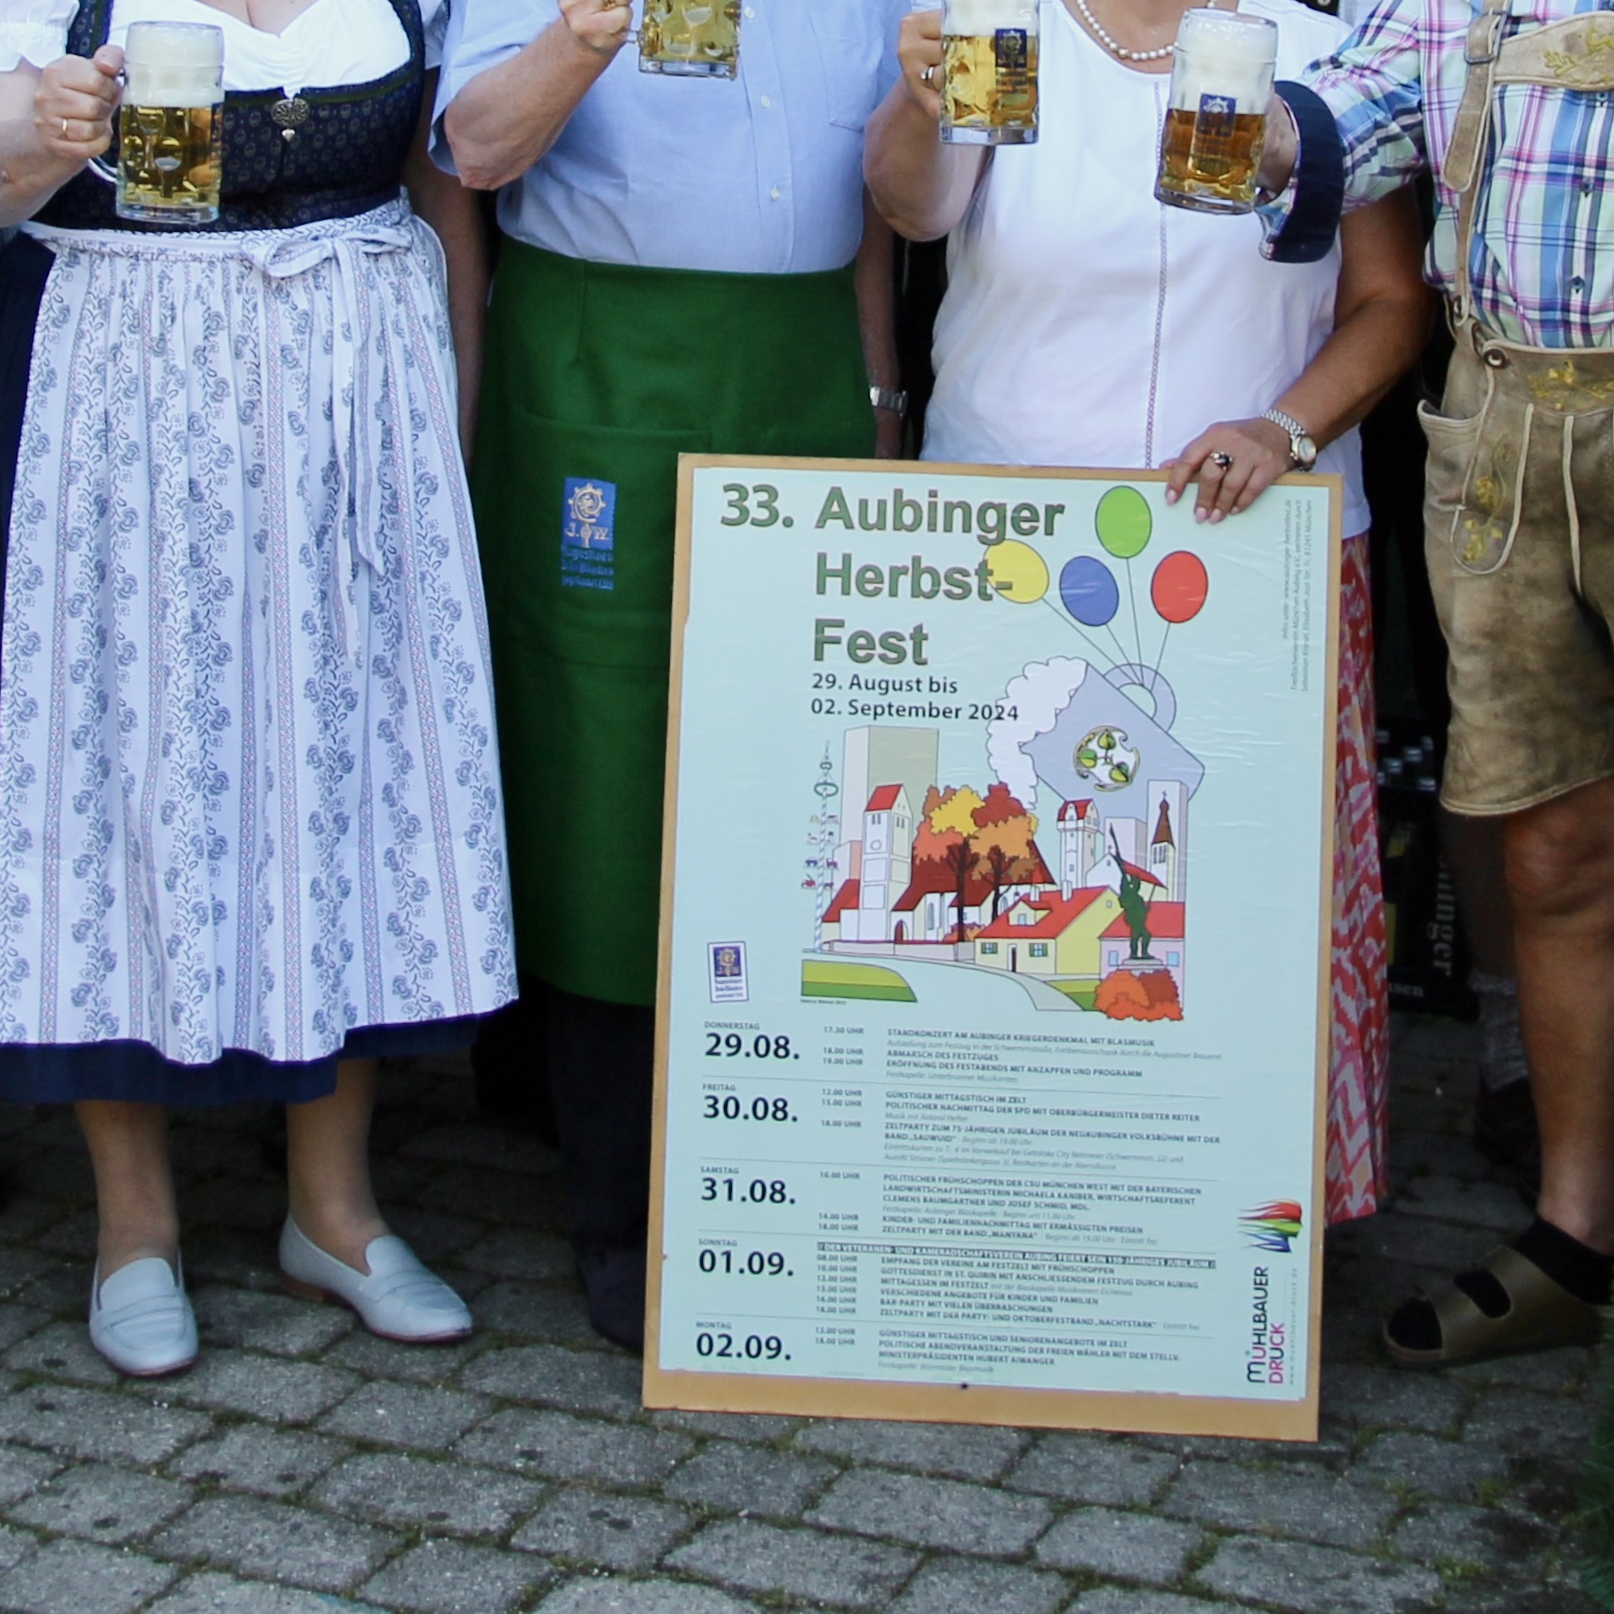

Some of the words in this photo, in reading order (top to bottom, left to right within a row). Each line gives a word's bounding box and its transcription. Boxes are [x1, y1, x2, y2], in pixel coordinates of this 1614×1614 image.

[719, 482, 795, 528] 33.
[814, 486, 1066, 545] Aubinger
[815, 553, 1013, 601] Herbst-
[813, 618, 928, 666] Fest
[811, 673, 843, 693] 29.
[848, 675, 923, 697] August
[930, 677, 958, 694] bis
[811, 699, 842, 716] 02.
[847, 700, 962, 721] September
[967, 703, 1020, 721] 2024
[704, 1021, 760, 1030] DONNERSTAG
[704, 1031, 800, 1060] 29.08.
[887, 1028, 953, 1038] STANDKONZERT
[953, 1030, 968, 1039] AM
[968, 1031, 1011, 1041] AUBINGER
[1089, 1036, 1106, 1045] MIT
[1106, 1037, 1154, 1047] BLASMUSIK
[886, 1048, 933, 1058] ABMARSCH
[934, 1050, 951, 1059] DES
[951, 1051, 998, 1061] FESTZUGES
[886, 1058, 937, 1069] ERÖFFNUNG
[937, 1061, 954, 1070] DES
[955, 1062, 1008, 1072] FESTABENDS
[1009, 1064, 1025, 1073] MIT
[1026, 1065, 1071, 1075] ANZAPFEN
[1071, 1067, 1091, 1076] UND
[1092, 1067, 1142, 1078] PROGRAMM
[702, 1083, 736, 1091] FREITAG
[885, 1089, 933, 1100] GÜNSTIGER
[933, 1092, 995, 1103] MITTAGSTISCH
[1007, 1095, 1026, 1104] ZELT
[703, 1093, 798, 1122] 30.08.
[884, 1100, 938, 1110] POLITISCHER
[939, 1103, 994, 1113] NACHMITTAG
[995, 1105, 1013, 1114] DER
[1013, 1106, 1031, 1114] SPD
[1031, 1107, 1048, 1115] MIT
[1140, 1111, 1170, 1121] DIETER
[1171, 1113, 1200, 1122] REITER
[884, 1121, 930, 1131] ZELTPARTY
[930, 1123, 950, 1132] ZUM
[1049, 1128, 1067, 1137] DER
[1068, 1129, 1128, 1140] NEUAUBINGER
[1128, 1130, 1185, 1142] VOLKSBÜHNE
[1185, 1134, 1202, 1143] MIT
[1202, 1135, 1220, 1144] DER
[884, 1131, 908, 1140] BAND
[700, 1165, 739, 1174] SAMSTAG
[700, 1176, 796, 1205] 31.08.
[883, 1173, 936, 1183] POLITISCHER
[937, 1174, 1004, 1186] FRÜHSCHOPPEN
[1005, 1178, 1022, 1187] DER
[1023, 1179, 1041, 1188] CSU
[1041, 1179, 1084, 1190] MÜNCHEN
[1085, 1182, 1108, 1191] WEST
[1109, 1183, 1125, 1192] MIT
[1126, 1184, 1143, 1192] DER
[1144, 1184, 1201, 1195] BAYERISCHEN
[882, 1193, 921, 1203] CLEMENS
[921, 1195, 986, 1206] BAUMGARTNER
[986, 1198, 1006, 1207] UND
[1007, 1199, 1032, 1208] JOSEF
[1011, 1189, 1056, 1199] MICHAELA
[917, 1216, 936, 1225] UND
[1031, 1221, 1048, 1230] MIT
[1048, 1221, 1107, 1232] ERMÄSSIGTEN
[1108, 1225, 1143, 1234] PREISEN
[697, 1237, 738, 1246] SONNTAG
[698, 1248, 794, 1277] 01.09.
[881, 1256, 921, 1265] EMPFANG
[921, 1257, 939, 1266] DER
[939, 1258, 975, 1268] VEREINE
[975, 1260, 990, 1269] AM
[990, 1261, 1029, 1270] FESTZELT
[1030, 1263, 1046, 1271] MIT
[1047, 1262, 1114, 1274] FRÜHSCHOPPEN
[880, 1266, 942, 1277] GOTTESDIENST
[998, 1272, 1014, 1280] MIT
[1096, 1276, 1134, 1286] FESTZUG
[1134, 1278, 1165, 1287] DURCH
[1166, 1279, 1199, 1289] AUBING
[880, 1276, 937, 1287] MITTAGESSEN
[950, 1280, 988, 1289] FESTZELT
[880, 1287, 942, 1298] VERSCHIEDENE
[943, 1290, 987, 1300] ANGEBOTE
[1006, 1293, 1038, 1302] KINDER
[1039, 1295, 1058, 1303] UND
[1059, 1296, 1098, 1305] FAMILIEN
[926, 1299, 942, 1308] MIT
[943, 1300, 973, 1309] VIELEN
[695, 1320, 732, 1329] MONTAG
[879, 1308, 924, 1318] ZELTPARTY
[925, 1310, 941, 1319] MIT
[942, 1310, 960, 1319] DER
[991, 1313, 1010, 1322] UND
[695, 1331, 792, 1360] 02.09.
[878, 1327, 926, 1339] GÜNSTIGER
[927, 1331, 988, 1342] MITTAGSTISCH
[988, 1334, 1008, 1343] UND
[1108, 1339, 1127, 1348] ZELT
[878, 1339, 927, 1349] POLITISCHE
[1026, 1346, 1044, 1355] DER
[1045, 1347, 1075, 1356] FREIEN
[1075, 1347, 1110, 1358] WÄHLER
[1111, 1350, 1127, 1359] MIT
[1269, 1322, 1286, 1385] DRUCK
[975, 1354, 1009, 1364] HUBERT
